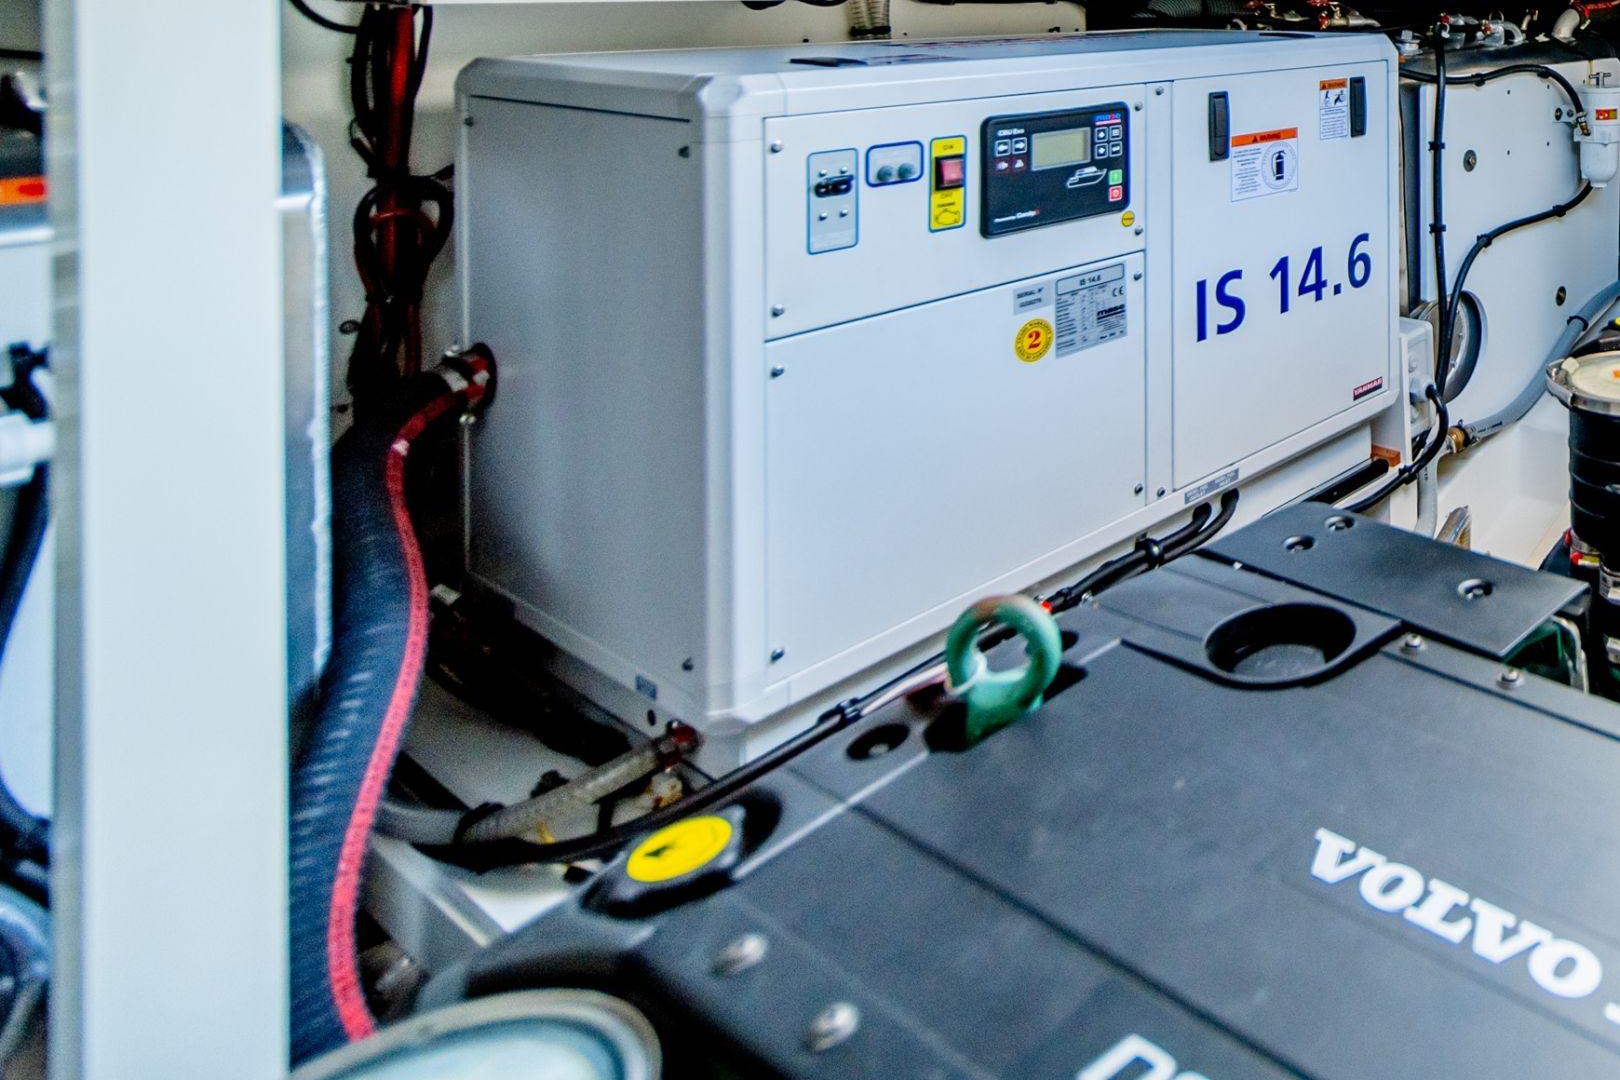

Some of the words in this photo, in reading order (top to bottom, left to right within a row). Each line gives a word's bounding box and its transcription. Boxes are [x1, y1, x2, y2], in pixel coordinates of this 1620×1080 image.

[1028, 330, 1041, 349] 2
[1196, 269, 1246, 343] IS
[1269, 232, 1372, 315] 14.6
[1310, 827, 1603, 998] VOLVO
